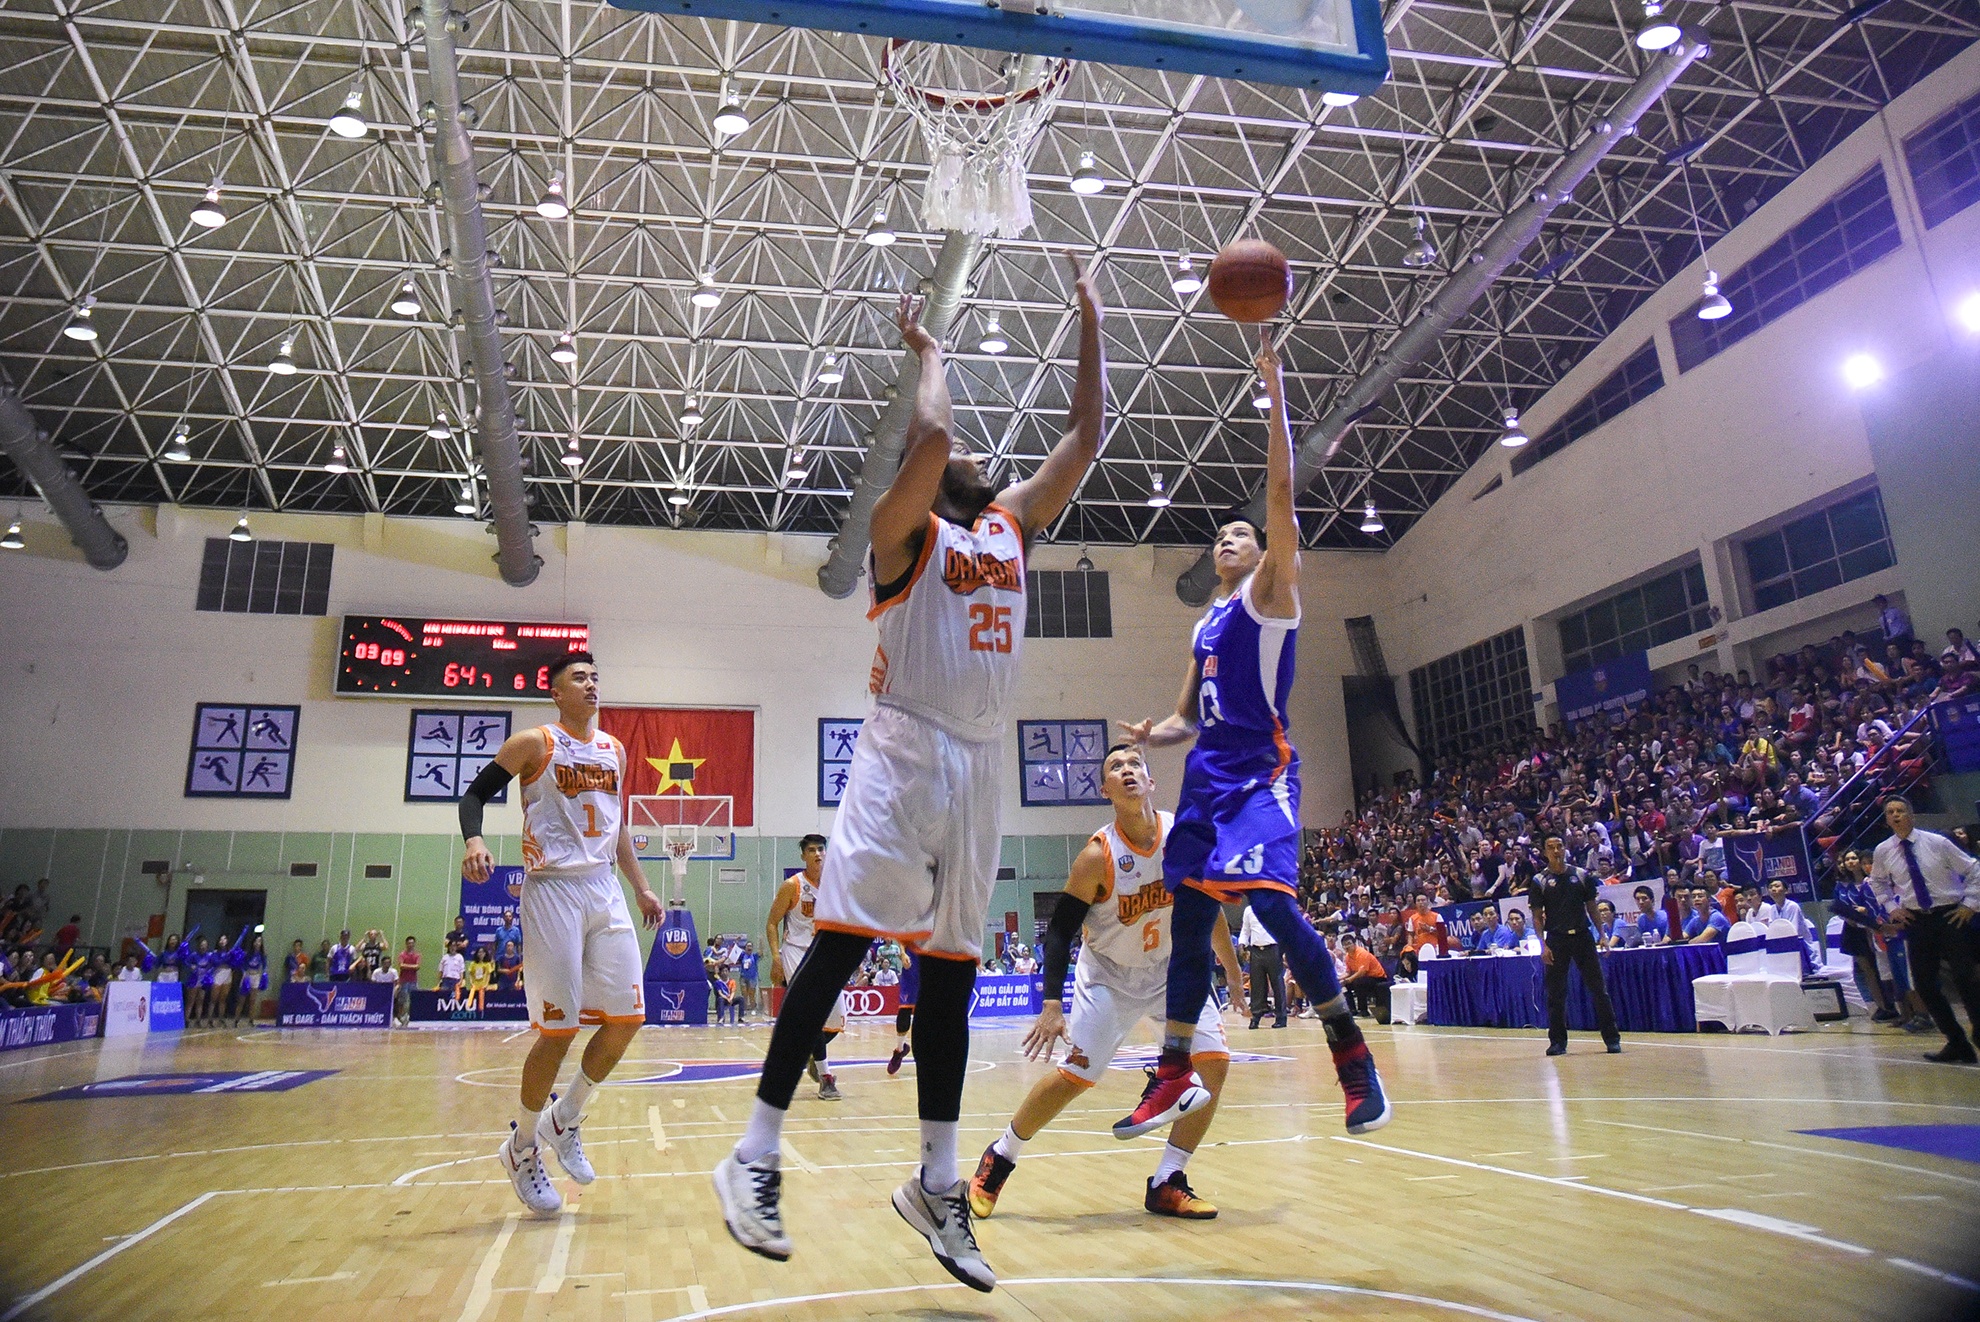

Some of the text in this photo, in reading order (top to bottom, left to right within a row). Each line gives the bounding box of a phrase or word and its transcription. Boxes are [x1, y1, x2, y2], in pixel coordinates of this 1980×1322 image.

[969, 603, 1012, 653] 25
[355, 643, 405, 666] 03 09
[443, 661, 477, 687] 64
[582, 803, 602, 837] 1
[1224, 843, 1264, 875] 23
[665, 930, 688, 943] VBA
[1142, 918, 1161, 953] 5
[632, 984, 643, 1010] 1
[980, 985, 997, 994] MÙA
[998, 983, 1014, 994] GIẢI
